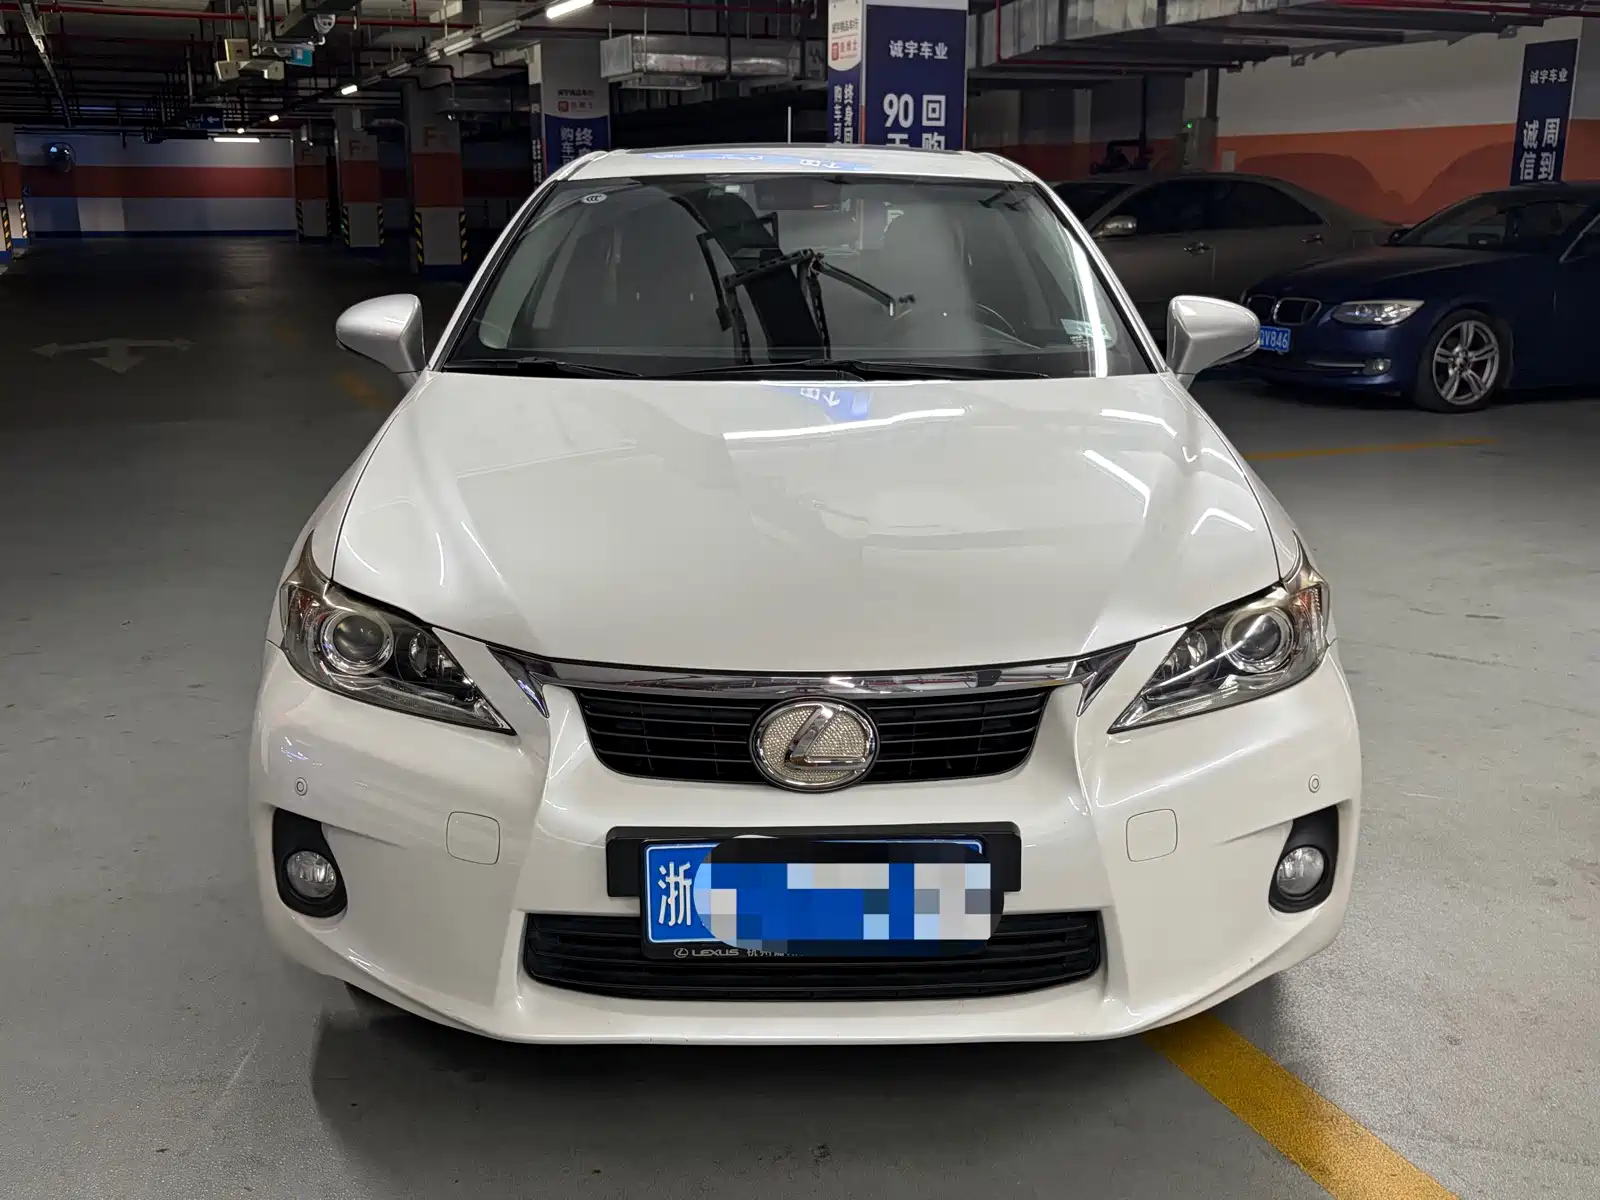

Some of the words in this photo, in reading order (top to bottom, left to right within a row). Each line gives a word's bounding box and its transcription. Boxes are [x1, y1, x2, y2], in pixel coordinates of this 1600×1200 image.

[889, 40, 948, 59] 诚宇车业
[658, 861, 692, 926] 浙
[691, 948, 739, 957] LEXUS
